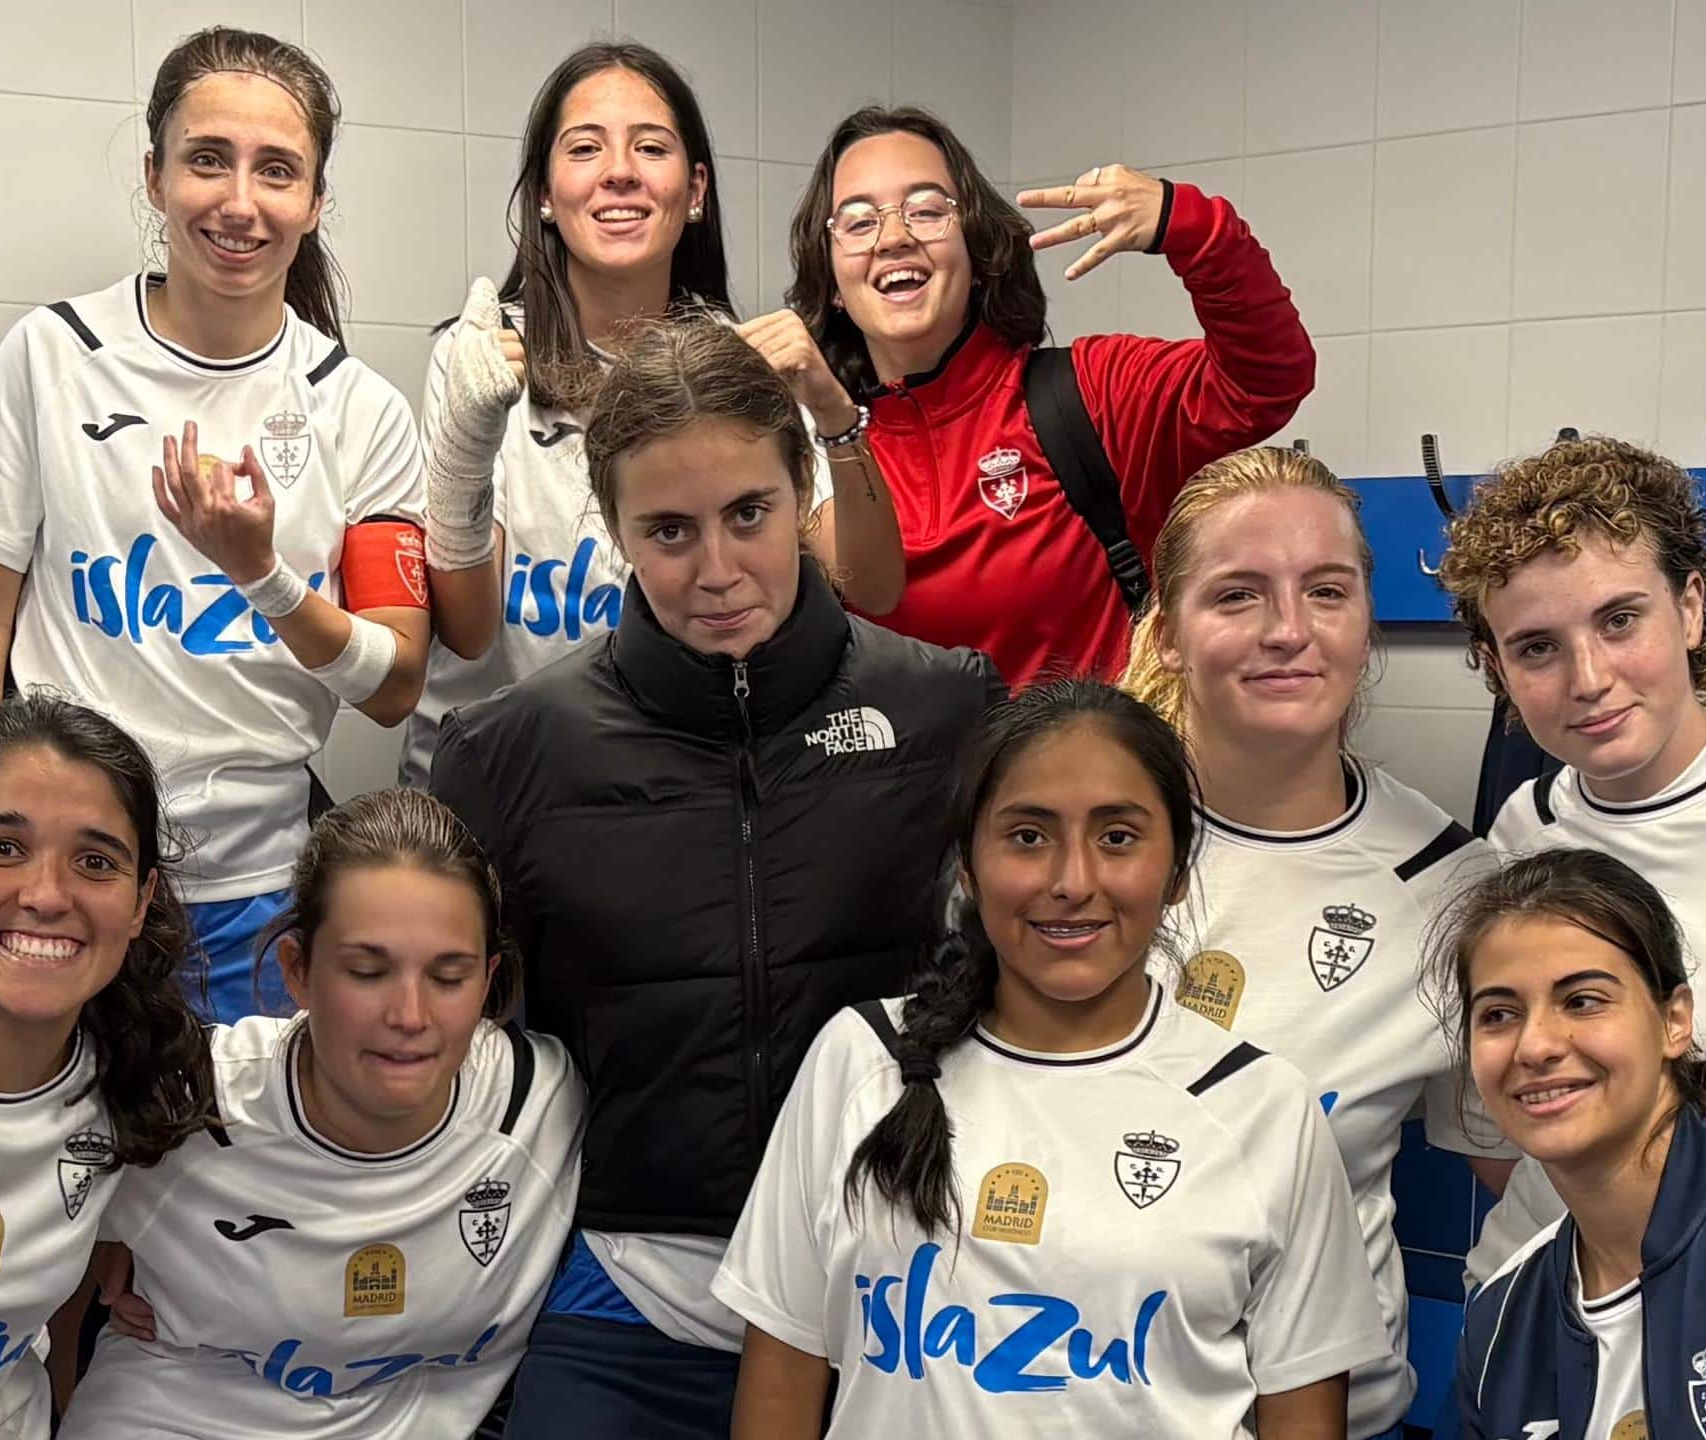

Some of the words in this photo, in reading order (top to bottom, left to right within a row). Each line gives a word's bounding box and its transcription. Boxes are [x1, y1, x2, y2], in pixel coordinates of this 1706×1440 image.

[71, 532, 326, 657] islaZ
[505, 537, 624, 642] isla
[825, 708, 860, 727] THE
[804, 721, 865, 747] NORTH
[824, 739, 867, 757] FACE
[983, 1213, 1035, 1229] MADRID
[853, 1241, 1168, 1394] islaZul
